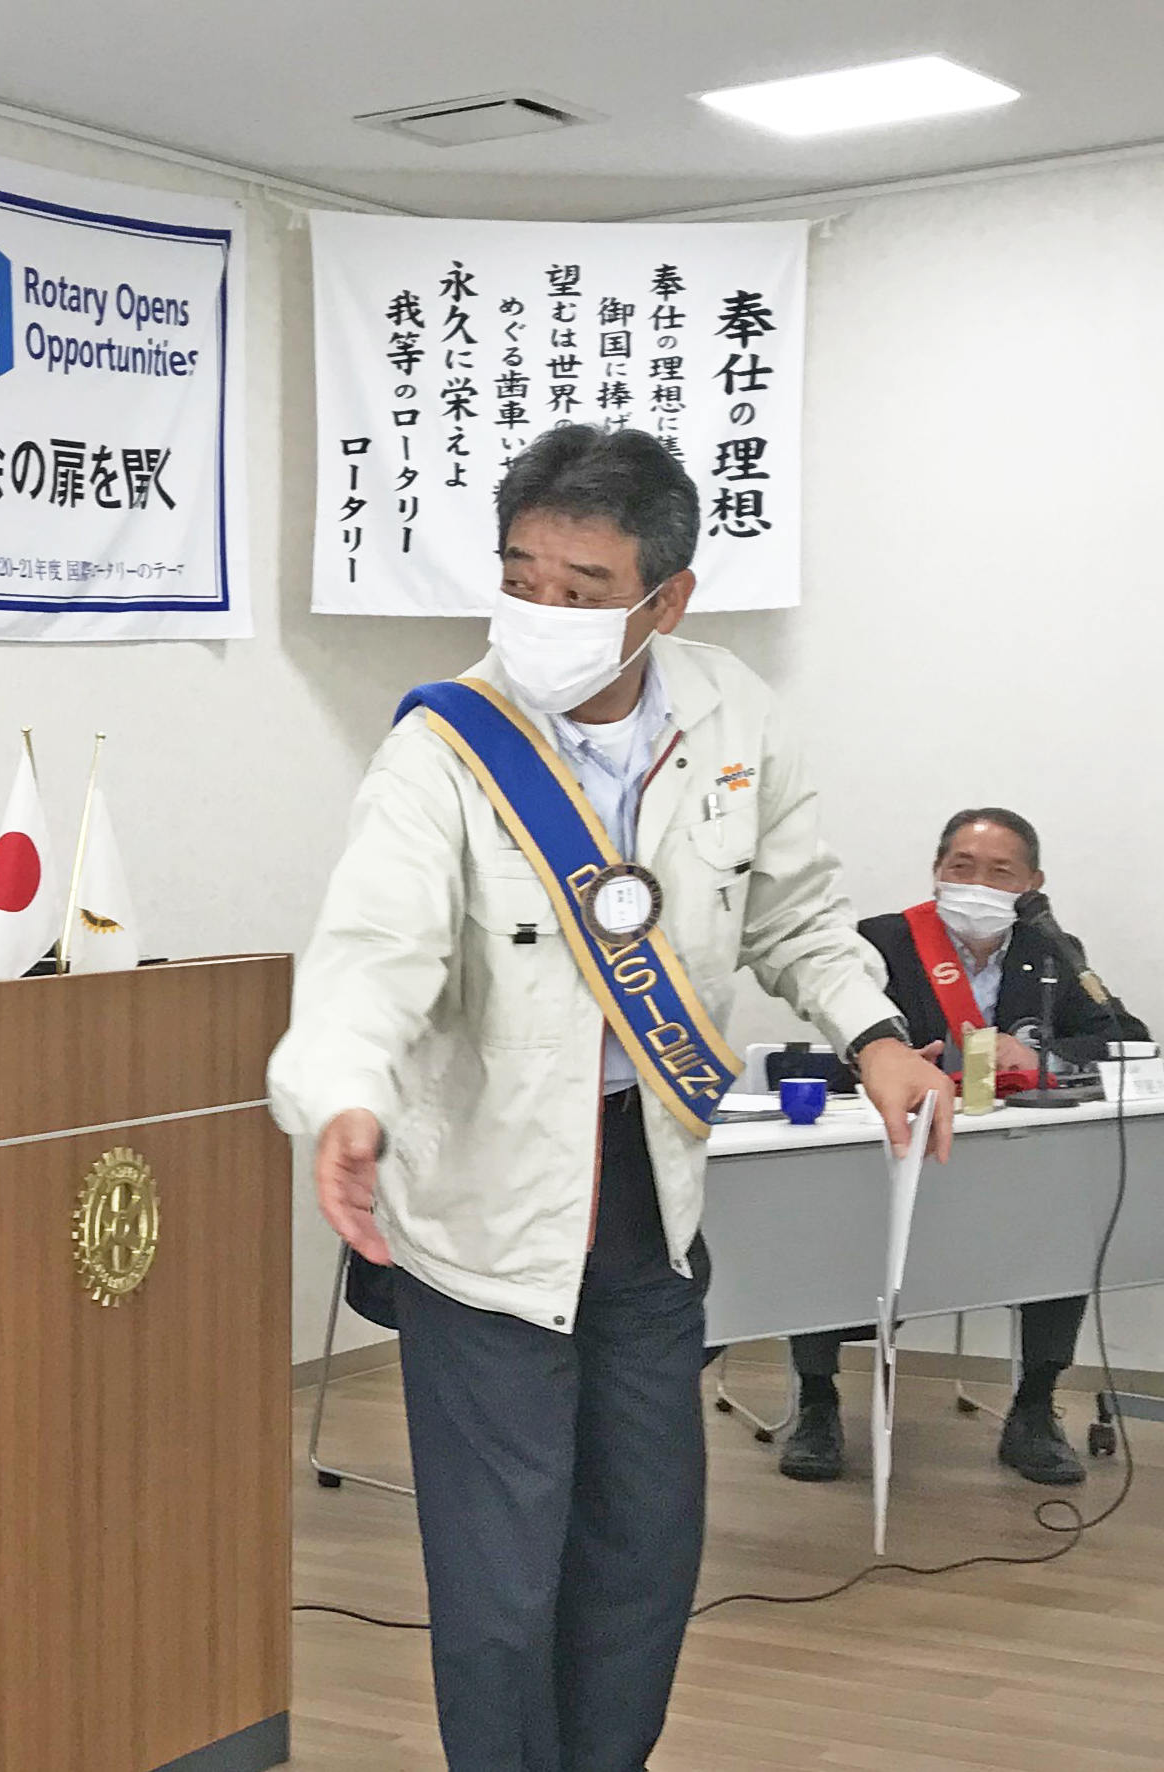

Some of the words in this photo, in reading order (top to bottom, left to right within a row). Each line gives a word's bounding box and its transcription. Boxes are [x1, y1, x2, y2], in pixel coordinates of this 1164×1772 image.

[24, 266, 108, 327] Rotary
[116, 283, 189, 328] Opens
[25, 322, 199, 377] Opportunities
[440, 261, 478, 487] 永久に栄えよ
[385, 290, 425, 553] 我等のロータリー
[708, 290, 777, 538] 奉仕の理想
[339, 437, 372, 583] ロータリー
[566, 864, 722, 1100] PSIDENT
[932, 961, 960, 985] S
